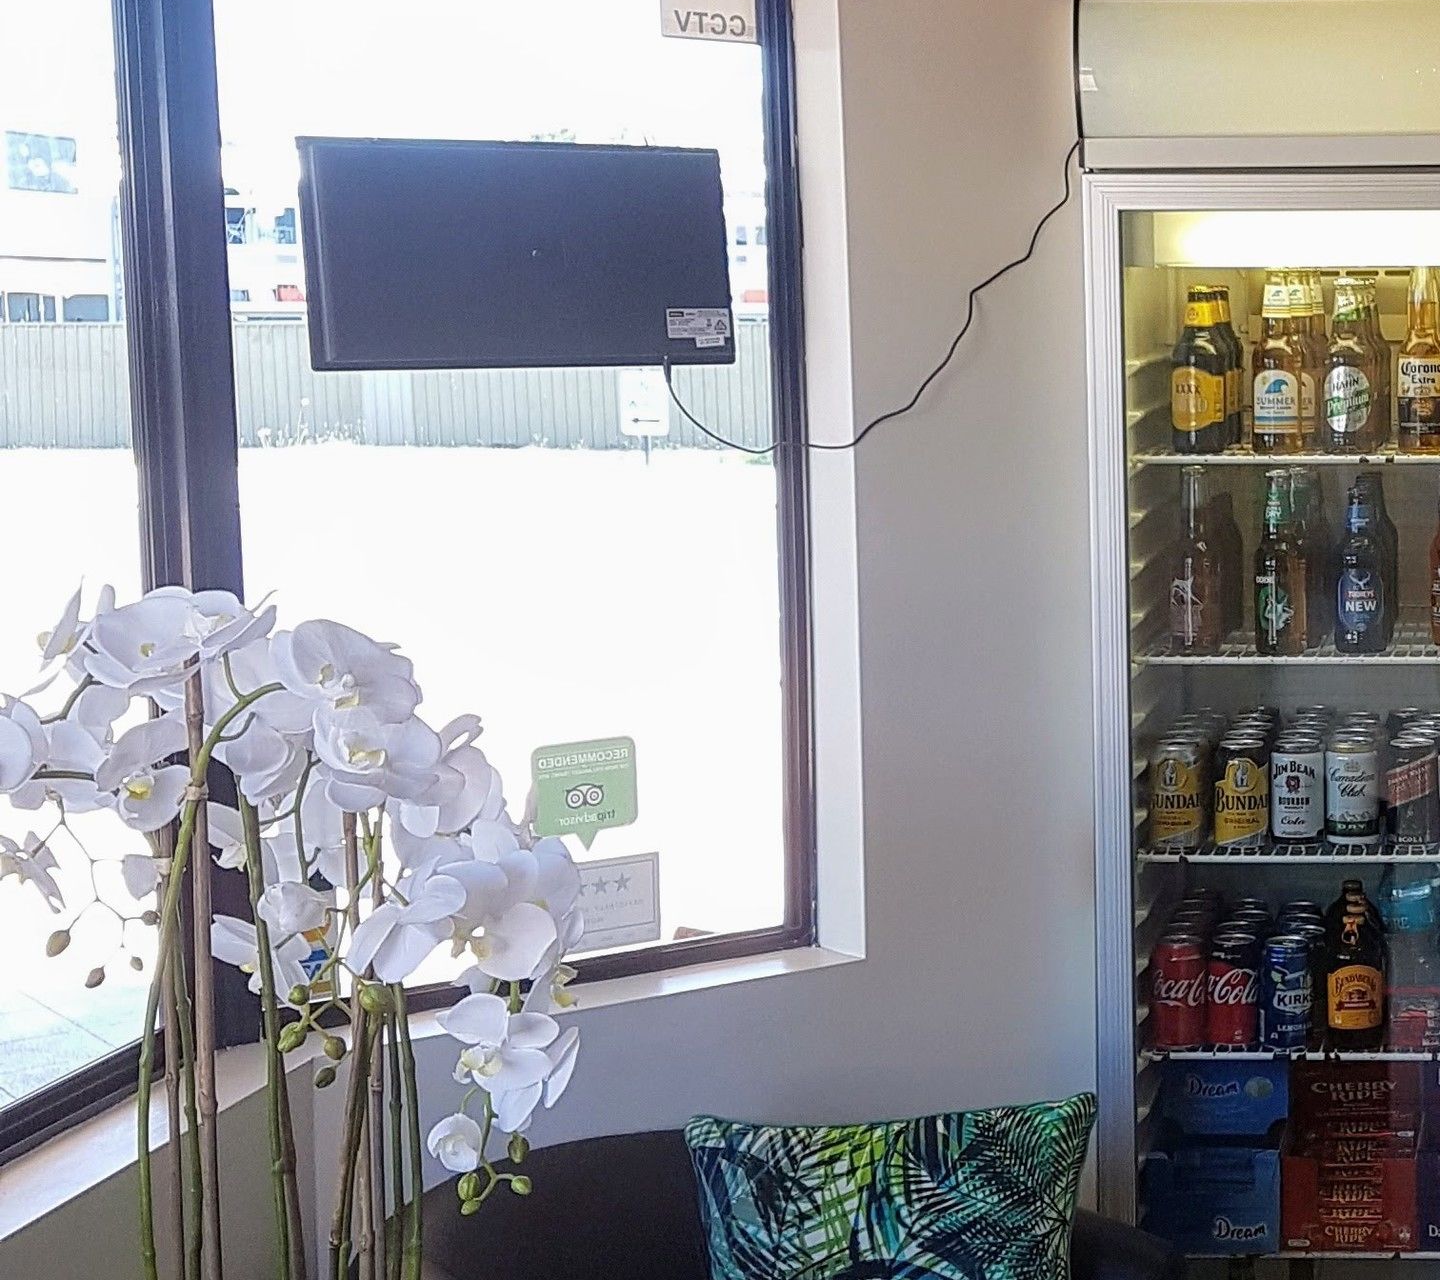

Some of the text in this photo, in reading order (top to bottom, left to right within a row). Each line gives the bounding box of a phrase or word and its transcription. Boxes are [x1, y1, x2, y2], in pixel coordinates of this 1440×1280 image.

[1256, 397, 1296, 405] SUMMER
[1345, 600, 1376, 612] NEW
[1273, 760, 1316, 780] JIM BEAM
[1338, 782, 1365, 797] Club
[1152, 793, 1200, 810] UNDA
[1280, 815, 1305, 826] Cola
[1188, 1075, 1239, 1098] Dream
[1311, 1081, 1397, 1095] CHERRY
[1332, 1090, 1385, 1103] RIPE
[1215, 1216, 1267, 1240] Dream
